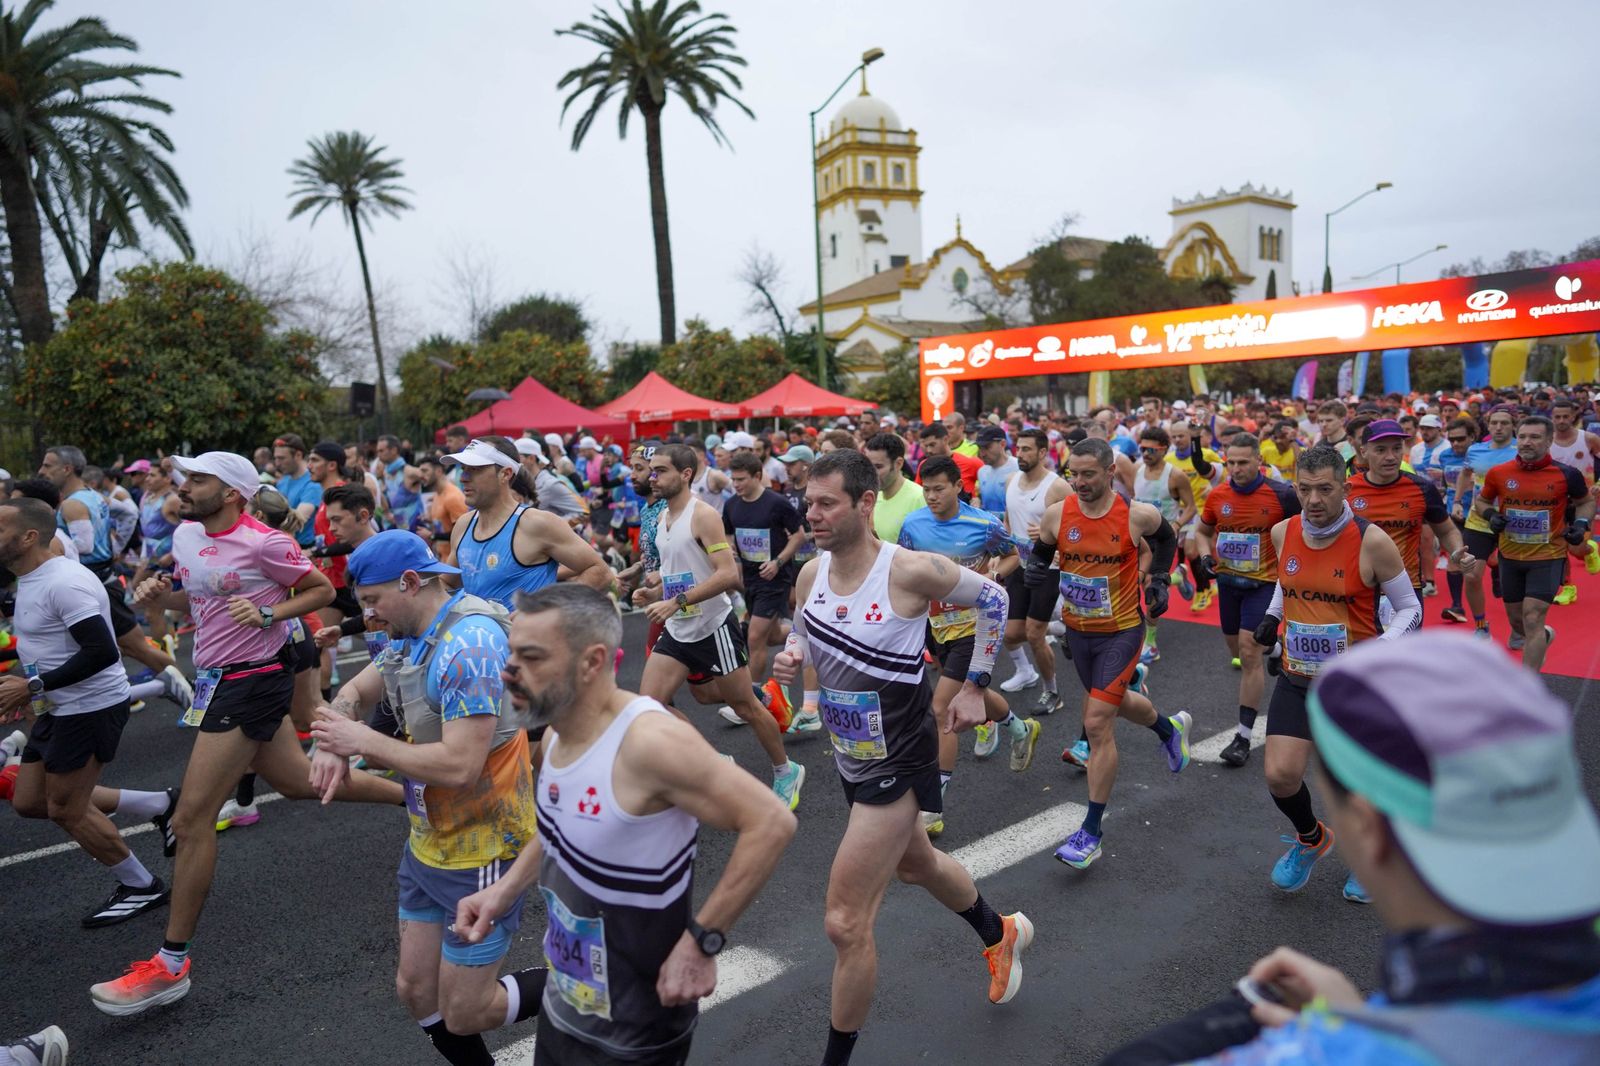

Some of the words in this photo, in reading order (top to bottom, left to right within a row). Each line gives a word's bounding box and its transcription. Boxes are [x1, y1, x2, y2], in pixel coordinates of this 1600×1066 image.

[1371, 300, 1444, 328] HOKA
[1457, 308, 1517, 324] HYUNDAI
[1511, 517, 1539, 530] 2622
[742, 537, 764, 548] 4046
[1222, 542, 1249, 555] 2957
[1066, 584, 1097, 602] 2722
[1301, 589, 1356, 605] CAMAS
[1293, 635, 1331, 654] 1808
[824, 704, 862, 731] 3830
